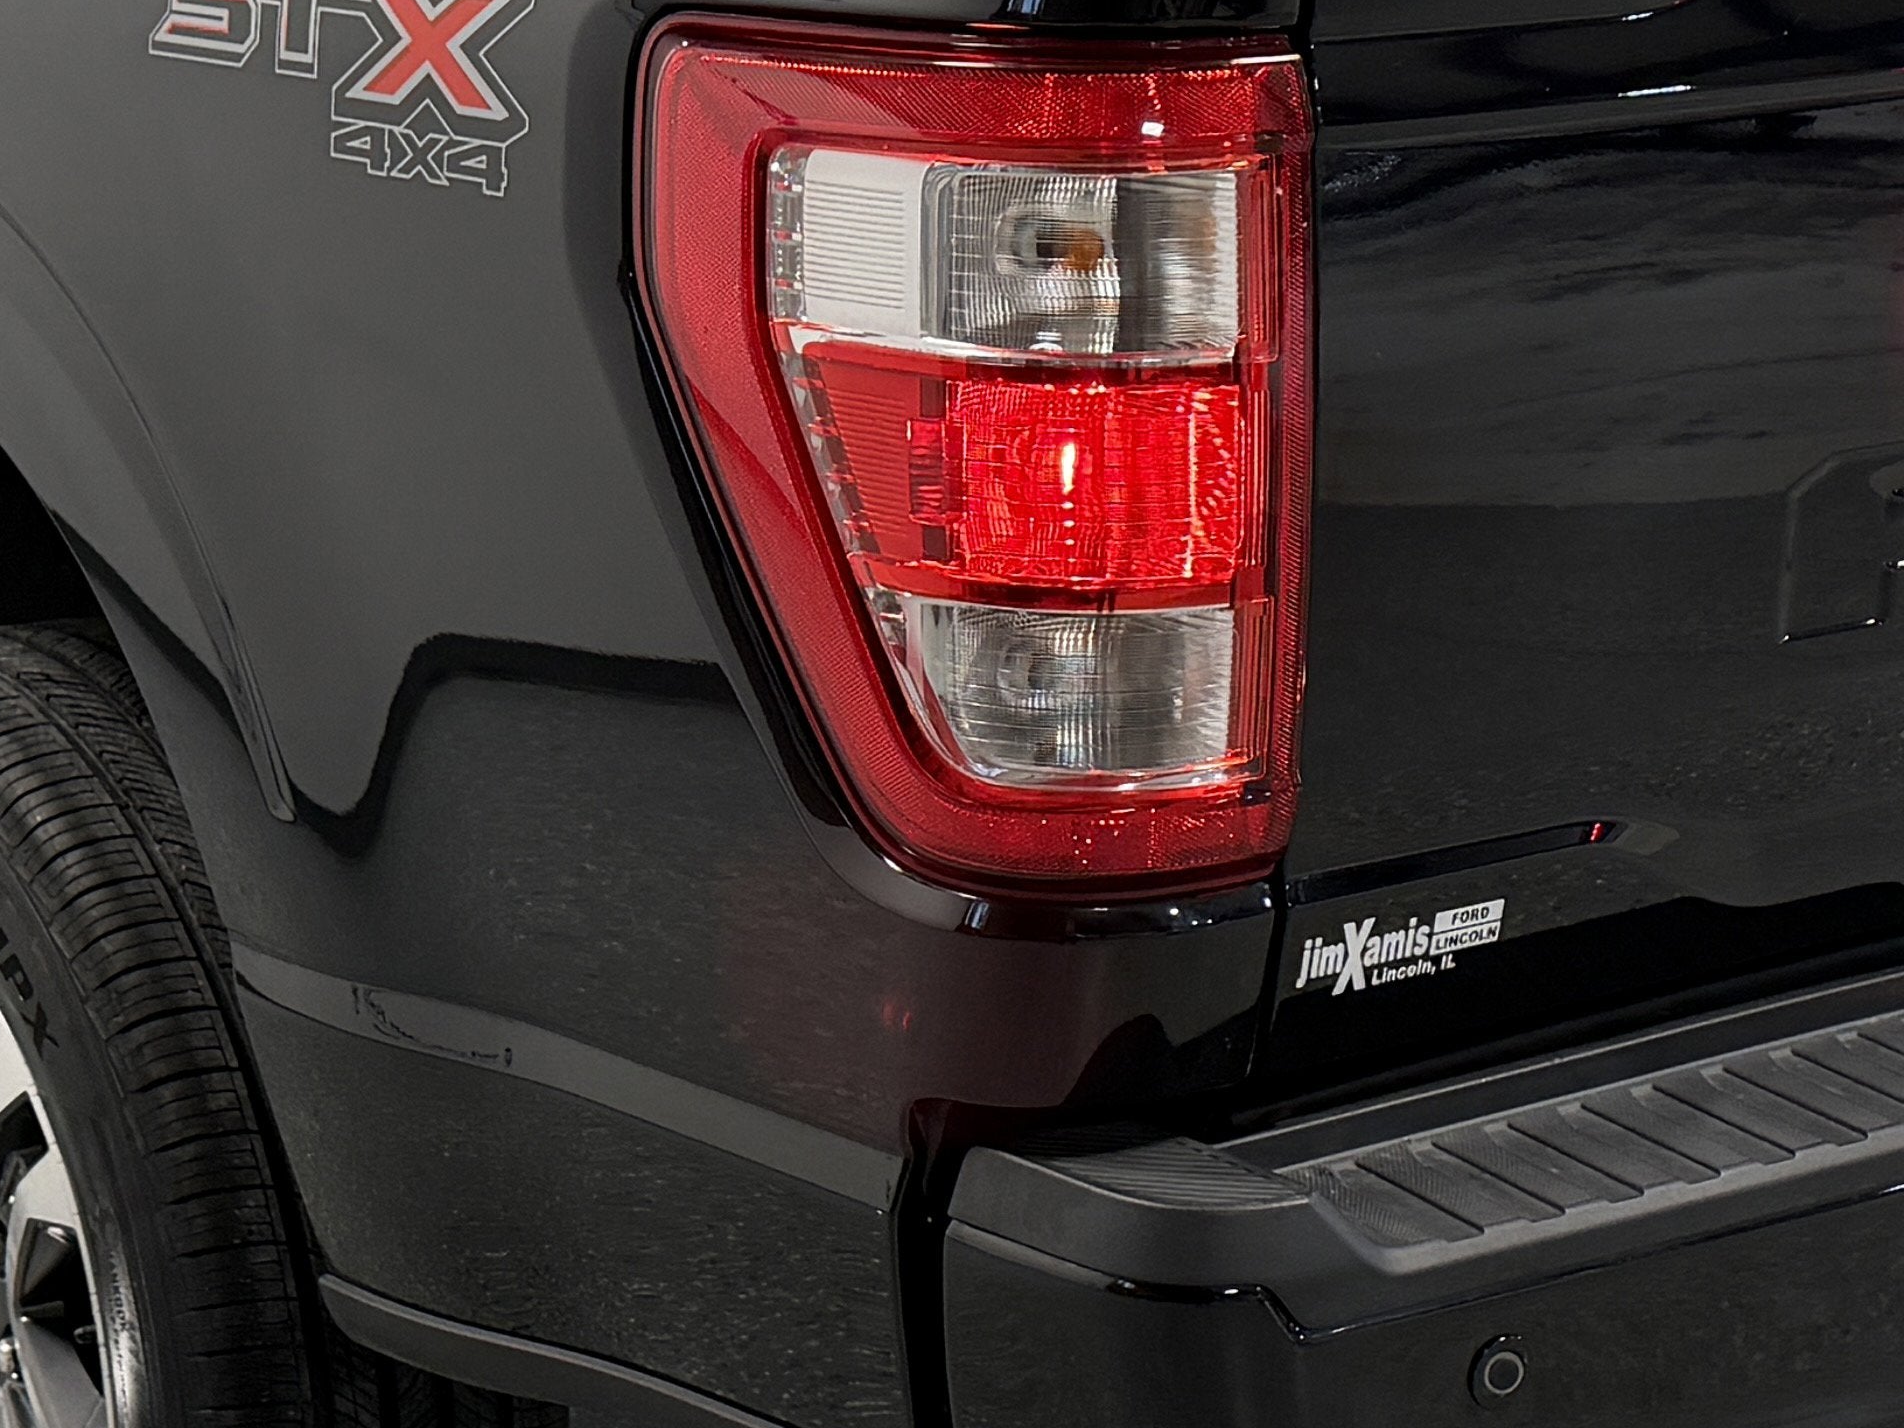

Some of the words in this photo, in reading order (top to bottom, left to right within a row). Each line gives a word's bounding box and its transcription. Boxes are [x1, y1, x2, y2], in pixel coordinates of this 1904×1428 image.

[1451, 906, 1490, 926] FORD
[1434, 926, 1497, 951] LINCOLN
[1371, 958, 1436, 986] Lincoln,
[1440, 954, 1456, 970] IL
